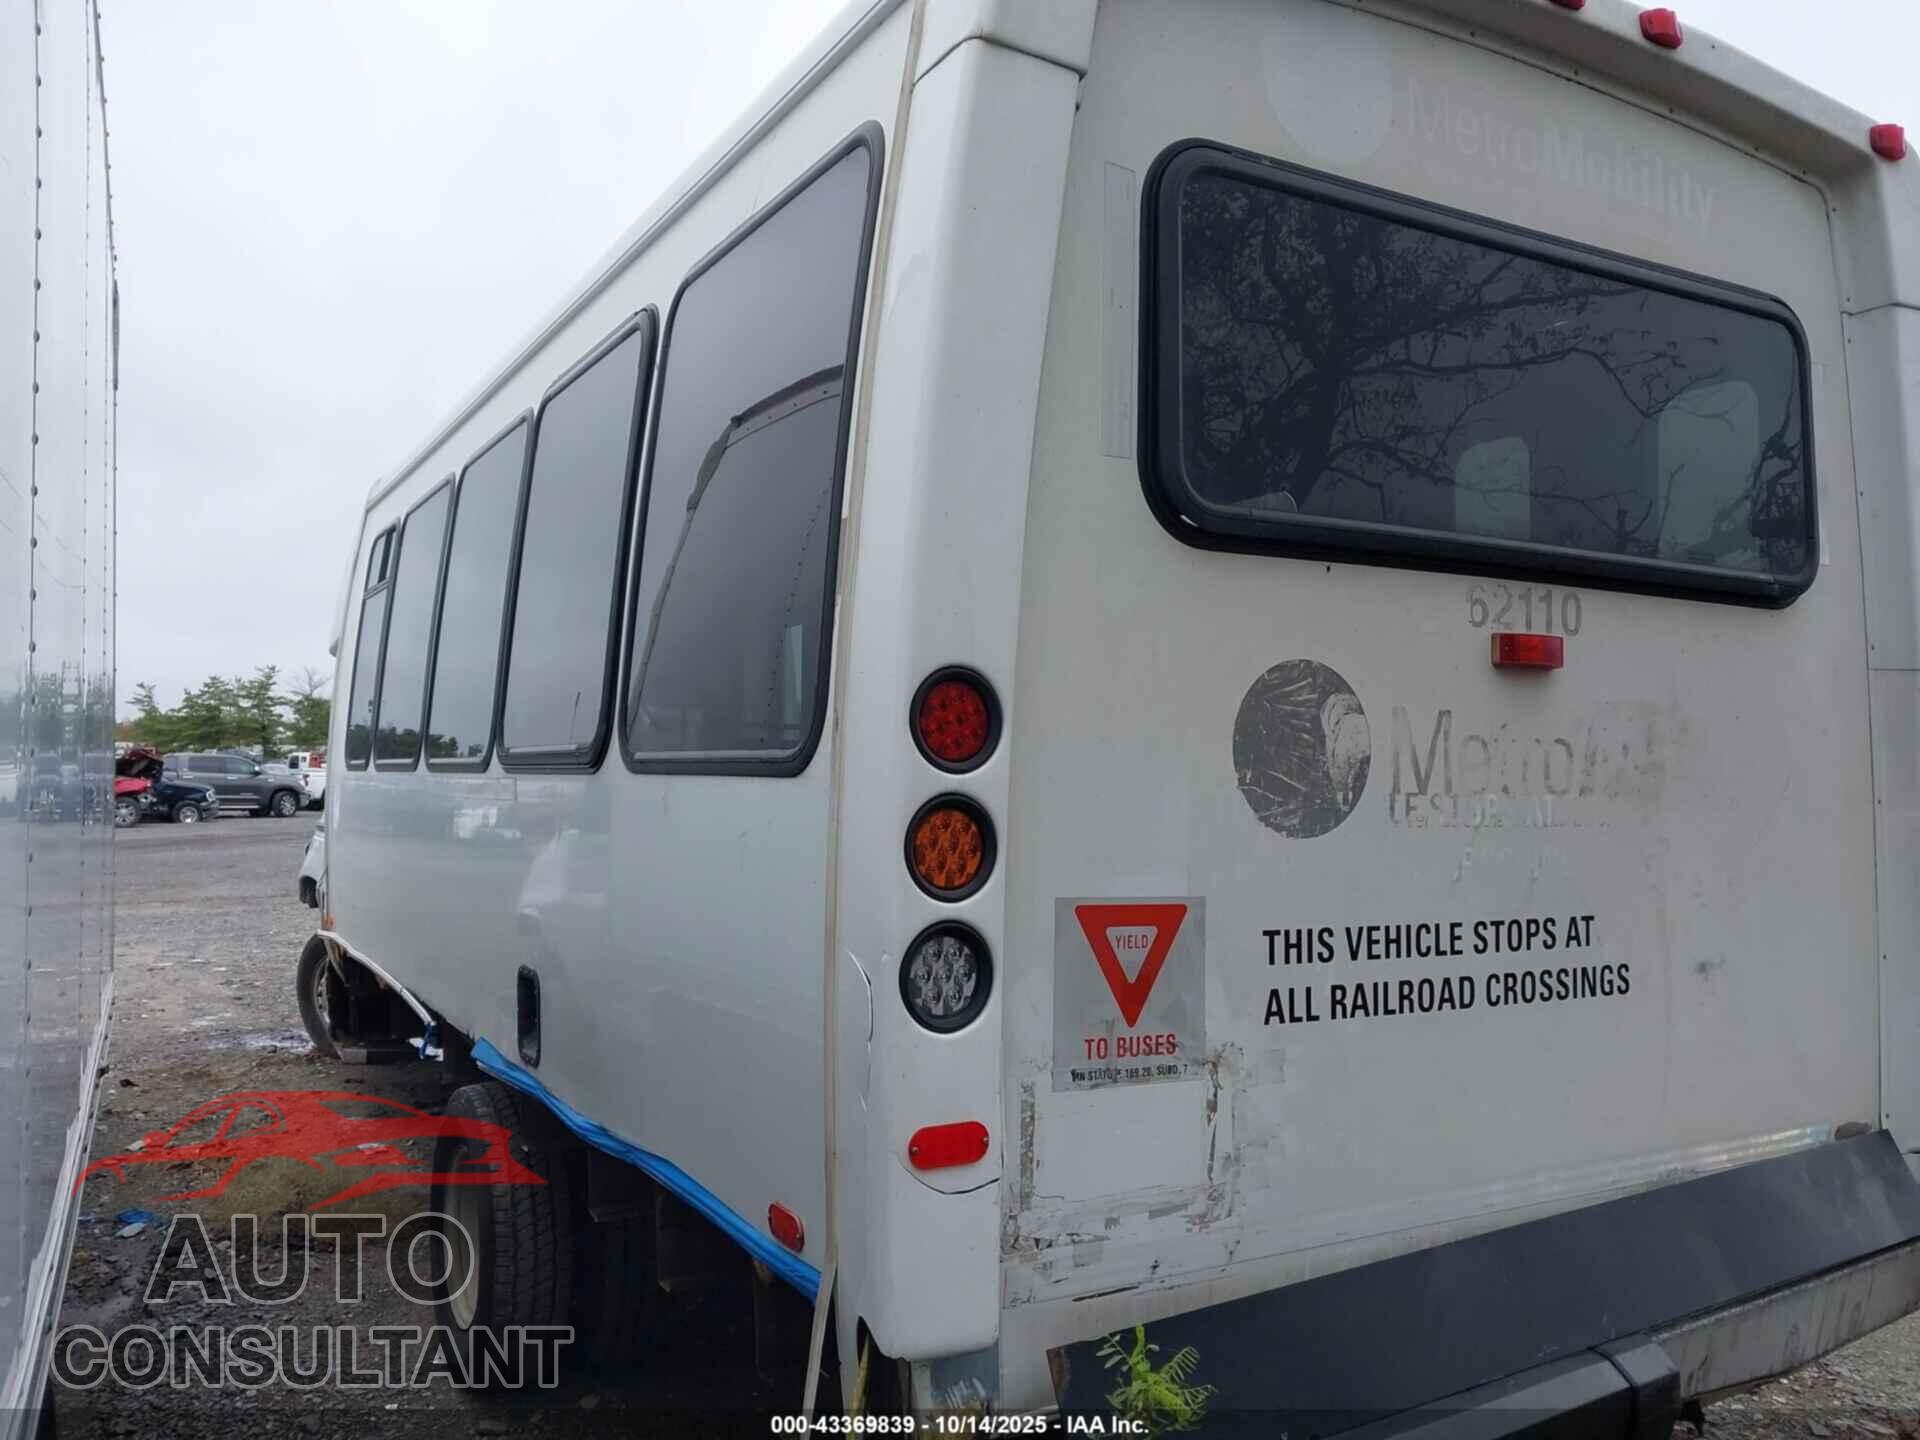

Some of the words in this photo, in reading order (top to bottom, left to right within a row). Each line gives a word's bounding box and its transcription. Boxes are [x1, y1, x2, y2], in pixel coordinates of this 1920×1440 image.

[1465, 584, 1583, 637] 62110
[1115, 934, 1149, 950] YIELD
[1262, 926, 1335, 966] THIS
[1345, 921, 1464, 962] VEHICLE
[1473, 916, 1557, 955] STOPS
[1565, 914, 1595, 949] AT
[1263, 985, 1321, 1026] ALL
[1330, 975, 1475, 1020] RAILROAD
[1486, 963, 1631, 1008] CROSSINGS
[1084, 1037, 1108, 1061] TO
[1117, 1033, 1178, 1059] BUSES
